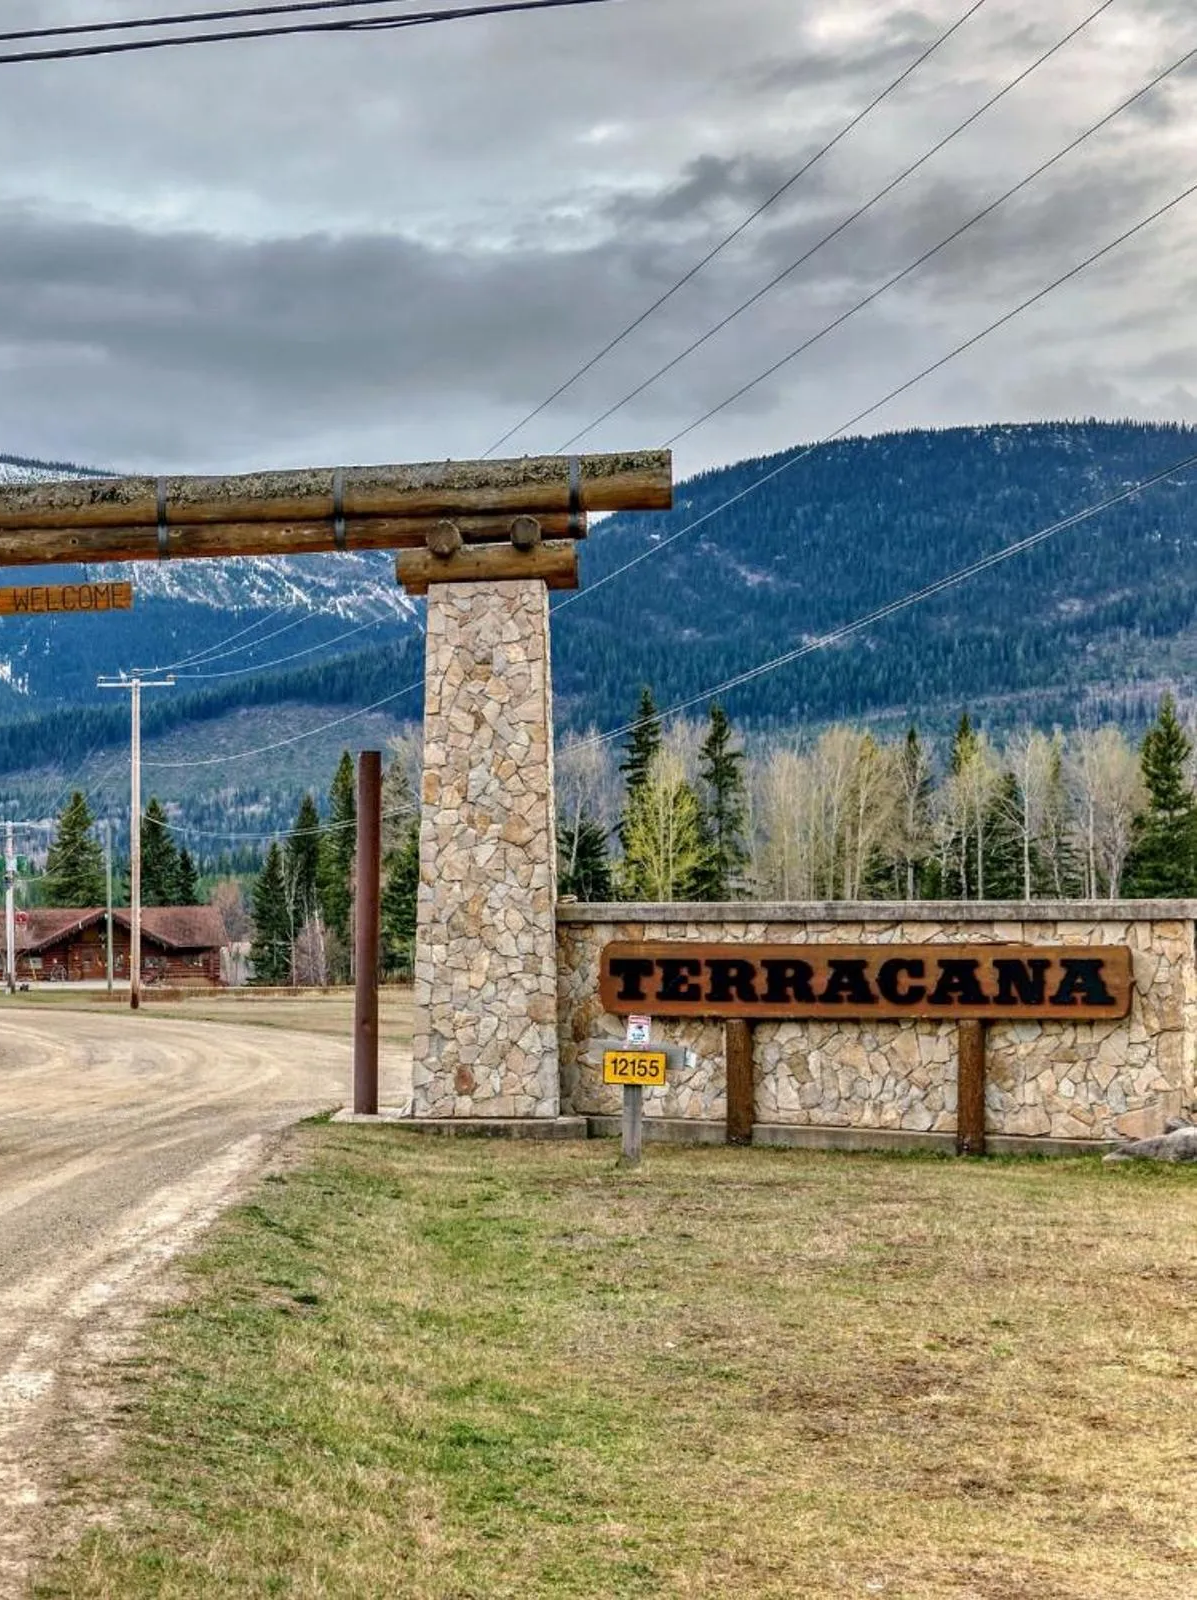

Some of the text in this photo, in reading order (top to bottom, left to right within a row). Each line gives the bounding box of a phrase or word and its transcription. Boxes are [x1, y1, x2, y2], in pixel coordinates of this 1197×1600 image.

[13, 582, 125, 613] WELCOME
[608, 957, 1116, 1006] TERRACANA
[611, 1057, 660, 1077] 12155
